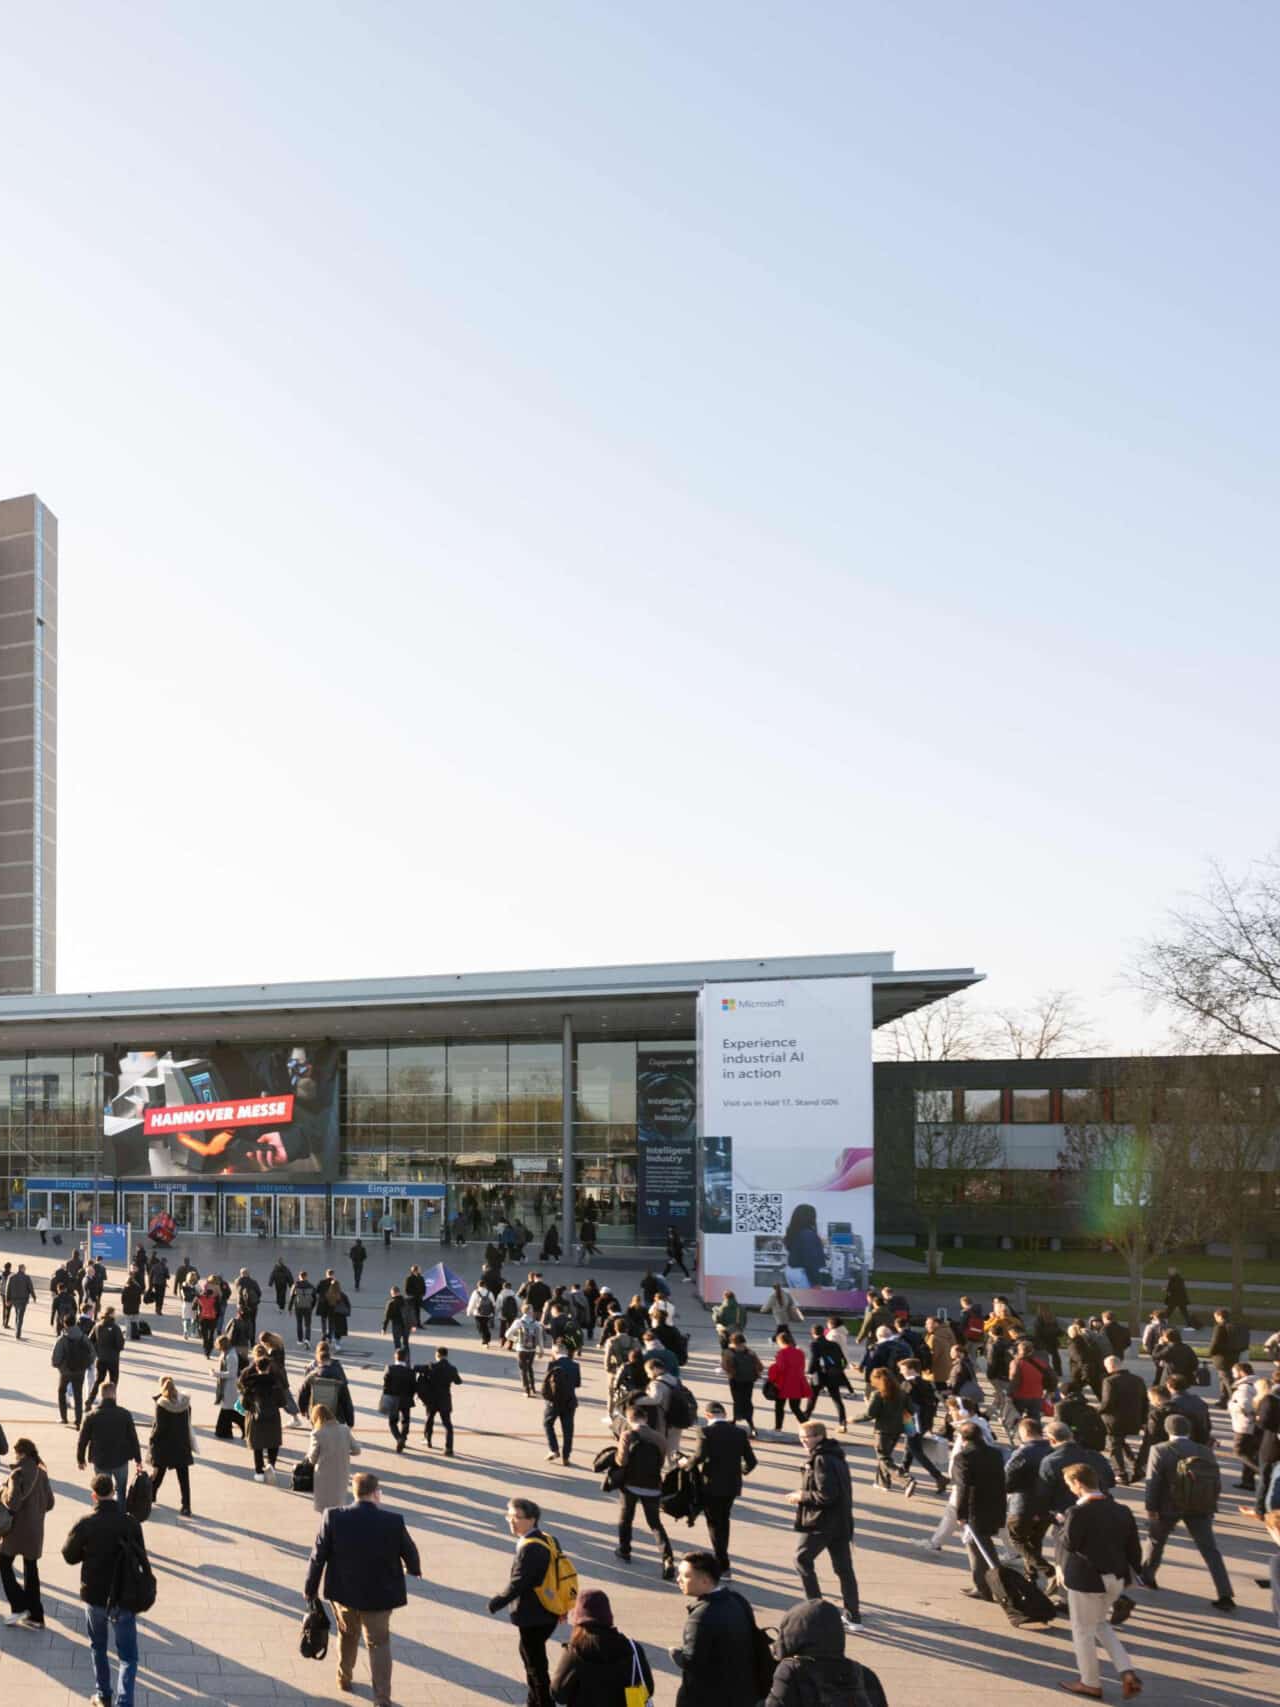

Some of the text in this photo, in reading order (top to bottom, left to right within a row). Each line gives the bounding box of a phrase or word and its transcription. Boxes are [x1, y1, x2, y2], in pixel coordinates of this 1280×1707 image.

[738, 998, 785, 1009] Microsoft
[722, 1038, 798, 1051] Experience
[722, 1051, 805, 1064] industrial AI
[722, 1067, 782, 1079] in action
[151, 1102, 287, 1127] HANNOVER MESSE
[153, 1180, 187, 1192] Eingang
[368, 1183, 406, 1194] Eingang
